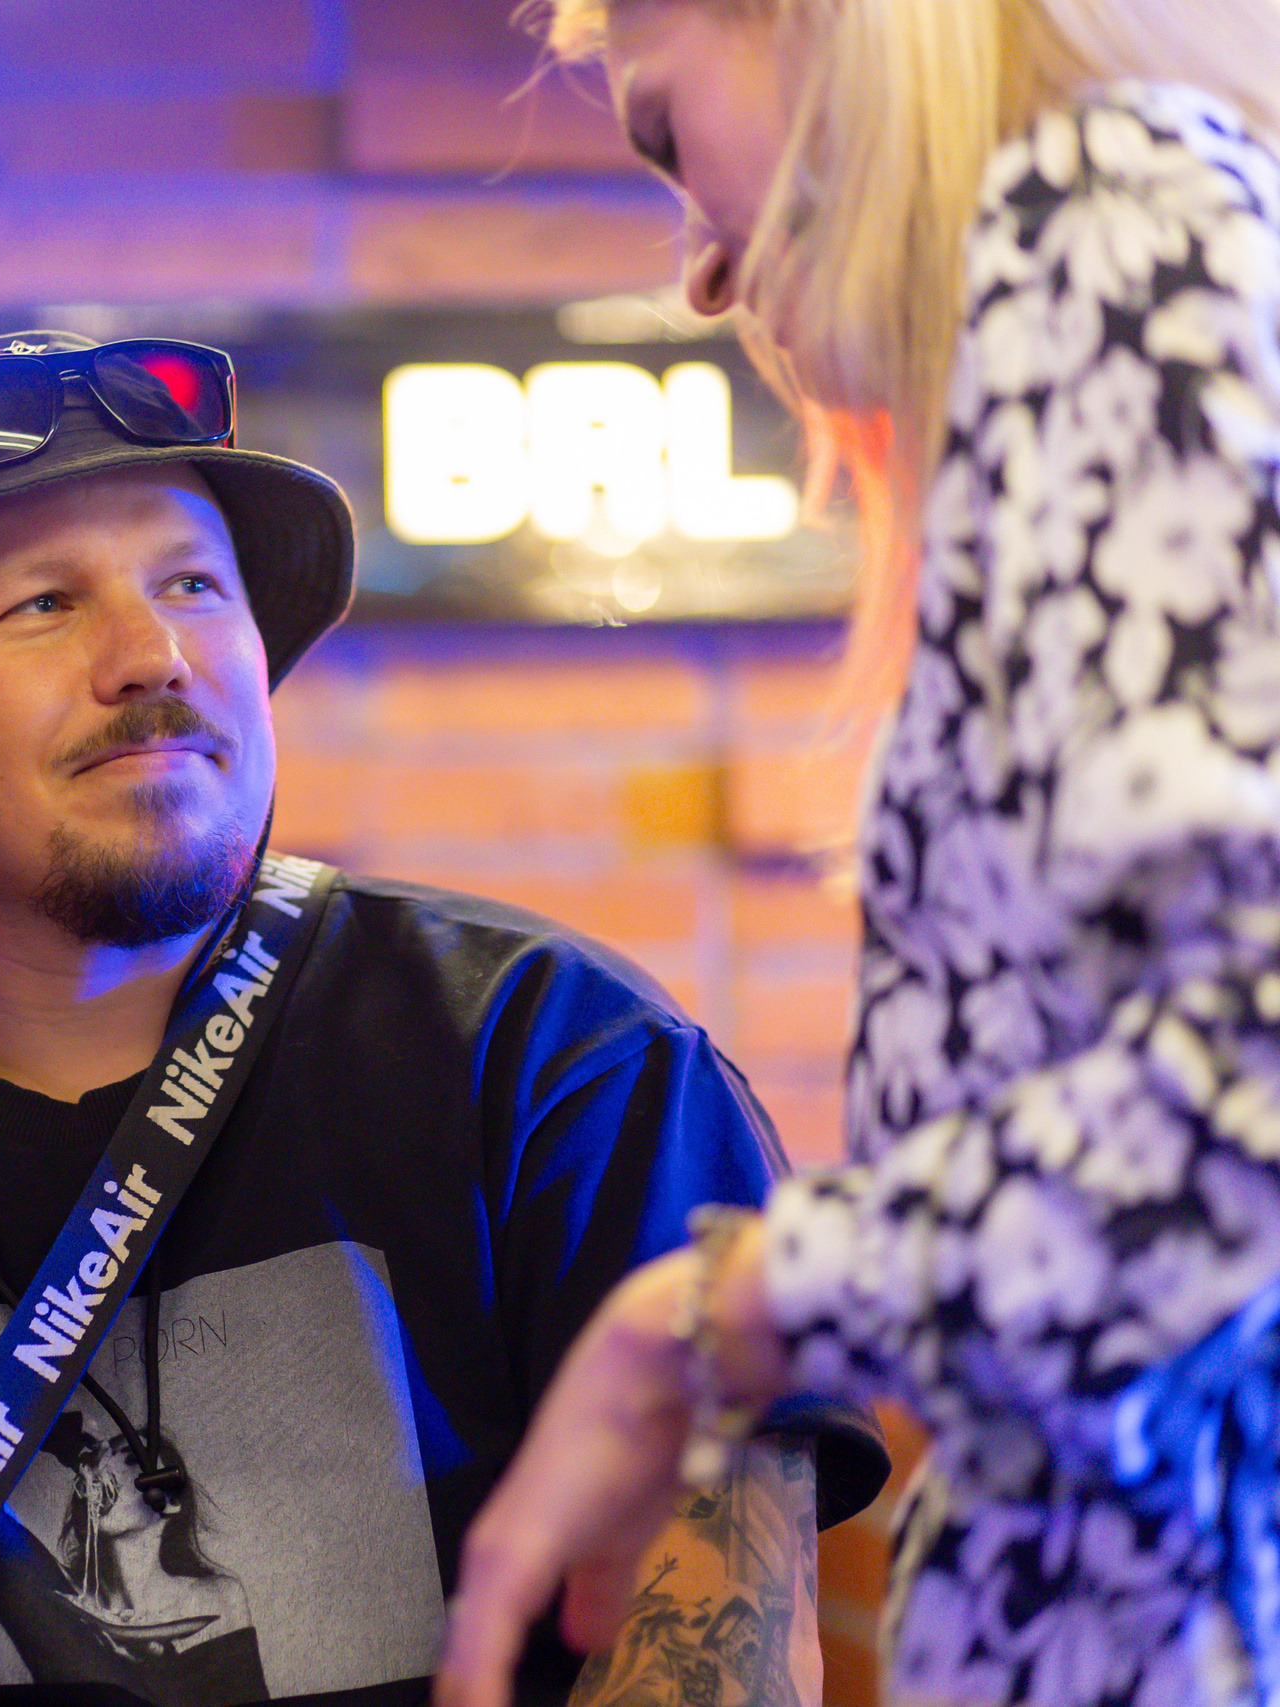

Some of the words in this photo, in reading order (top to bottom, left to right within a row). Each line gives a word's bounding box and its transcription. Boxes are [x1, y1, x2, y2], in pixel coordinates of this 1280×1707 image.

[13, 1163, 163, 1384] NikeAir
[147, 930, 282, 1146] NikeAir
[252, 856, 324, 919] Nik
